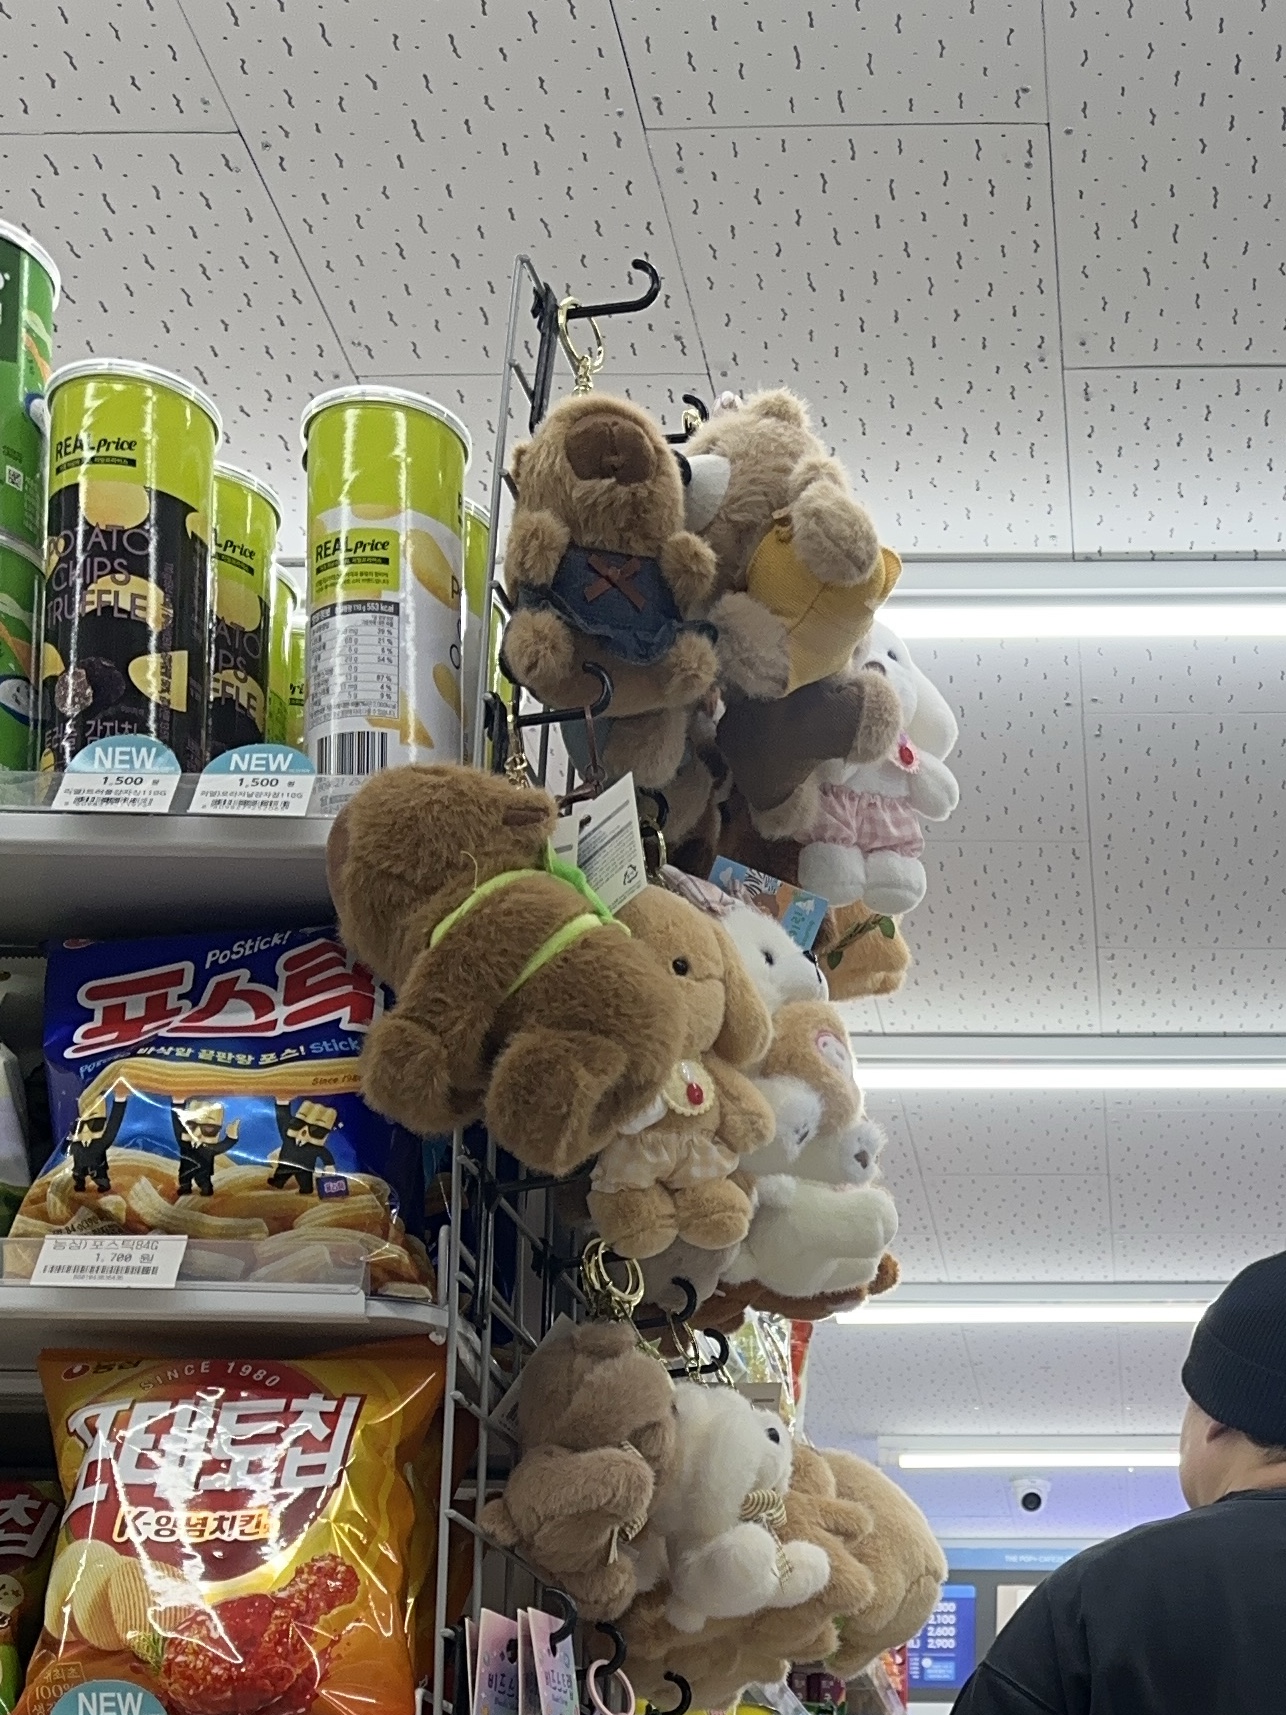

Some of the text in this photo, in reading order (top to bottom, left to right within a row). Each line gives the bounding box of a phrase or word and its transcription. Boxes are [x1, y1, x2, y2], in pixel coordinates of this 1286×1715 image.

[97, 437, 137, 452] Price
[353, 538, 390, 555] Price
[52, 558, 131, 591] CHIPS
[94, 747, 156, 769] NEW
[230, 753, 293, 772] NEW
[102, 776, 143, 786] 1,500
[238, 777, 279, 788] 1,500
[205, 930, 291, 970] PoStick!
[64, 937, 384, 1059] 포스틱
[309, 1037, 360, 1054] Stick
[142, 1361, 211, 1391] SINCE
[227, 1362, 280, 1387] 1980
[119, 1508, 272, 1541] K-양념치킨
